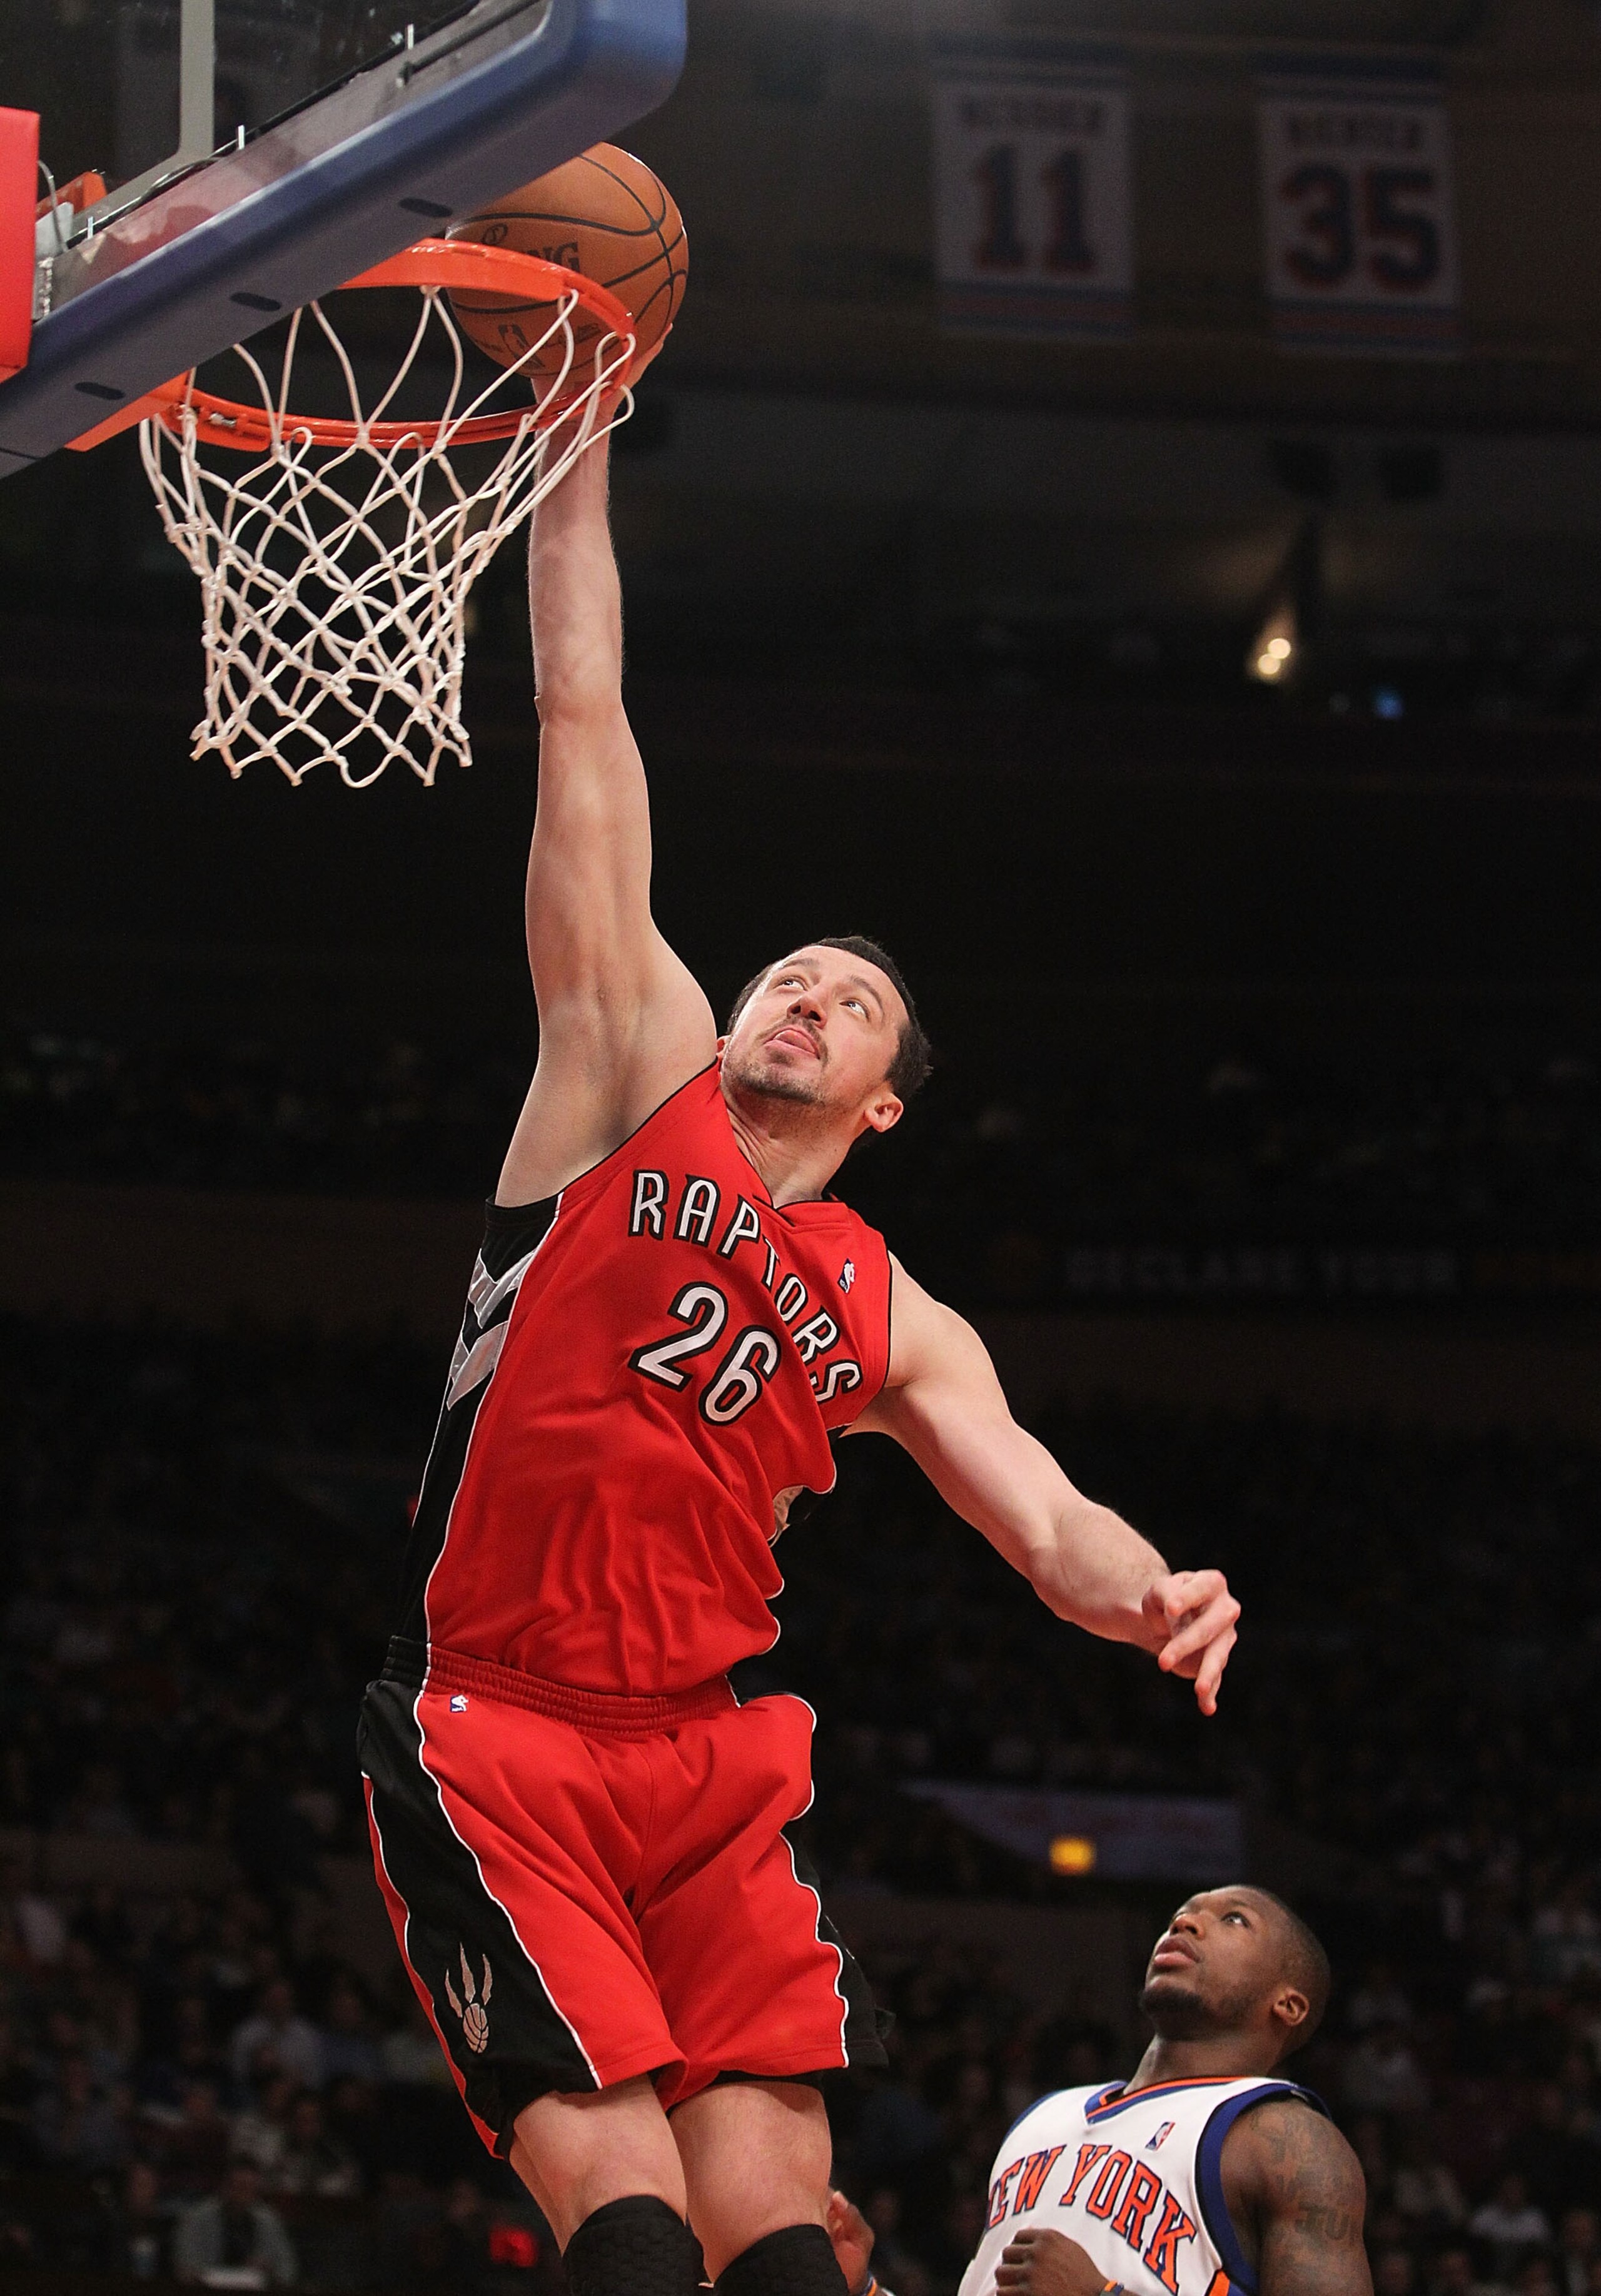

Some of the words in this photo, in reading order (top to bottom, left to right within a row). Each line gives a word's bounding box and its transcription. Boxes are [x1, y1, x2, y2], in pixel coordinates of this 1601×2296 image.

[972, 144, 1099, 274] 11
[1280, 164, 1442, 290] 35
[629, 1170, 863, 1403] RAPTORS
[629, 1282, 781, 1426] 26
[1059, 2144, 1196, 2295] YORK
